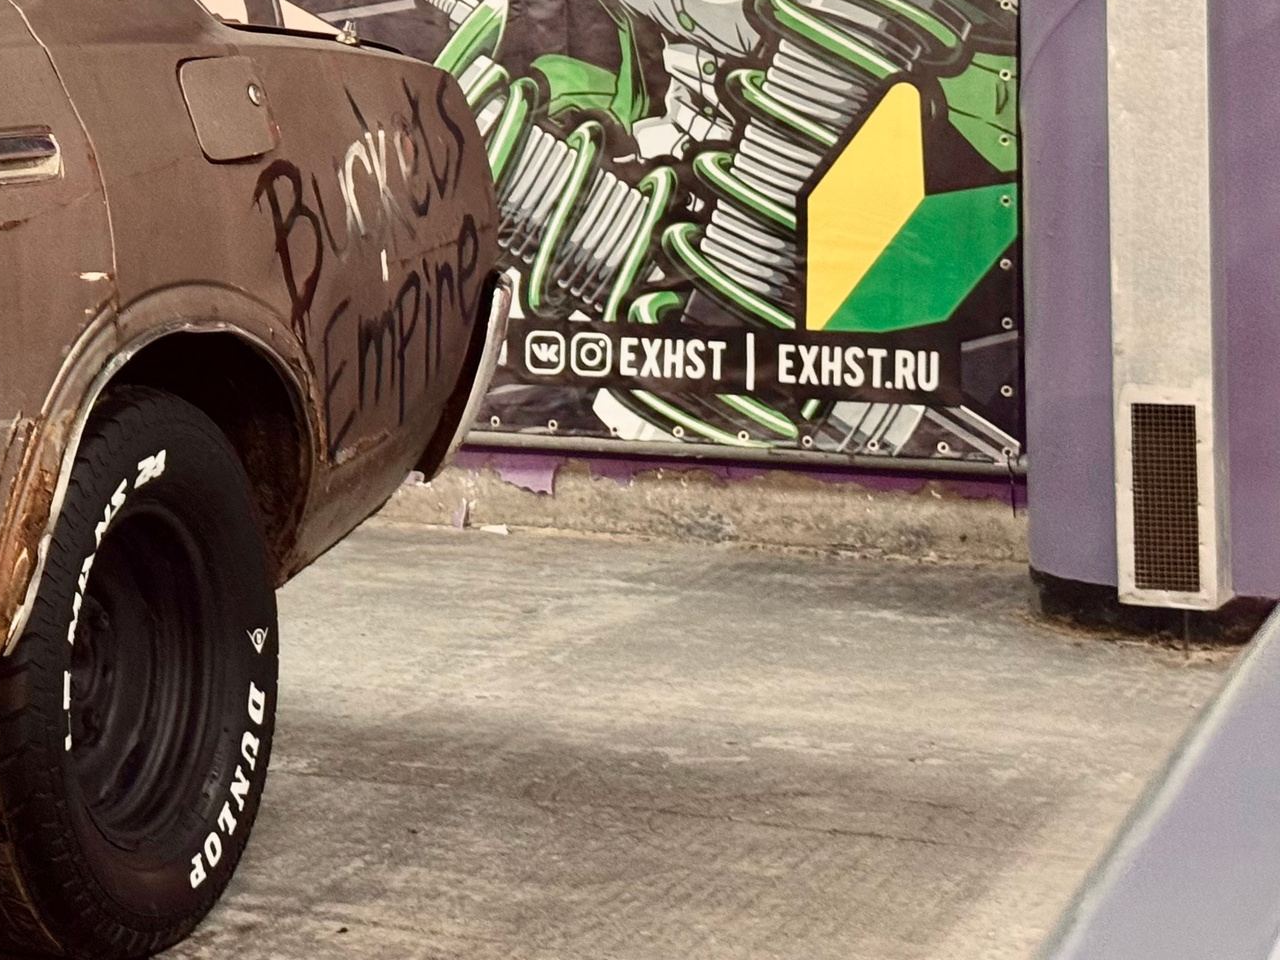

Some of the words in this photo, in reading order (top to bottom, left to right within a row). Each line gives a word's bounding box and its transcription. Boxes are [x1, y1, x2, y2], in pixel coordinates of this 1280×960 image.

[620, 336, 727, 381] EXHST
[777, 343, 940, 392] EXHST.RU
[190, 680, 266, 890] DUNLOP
